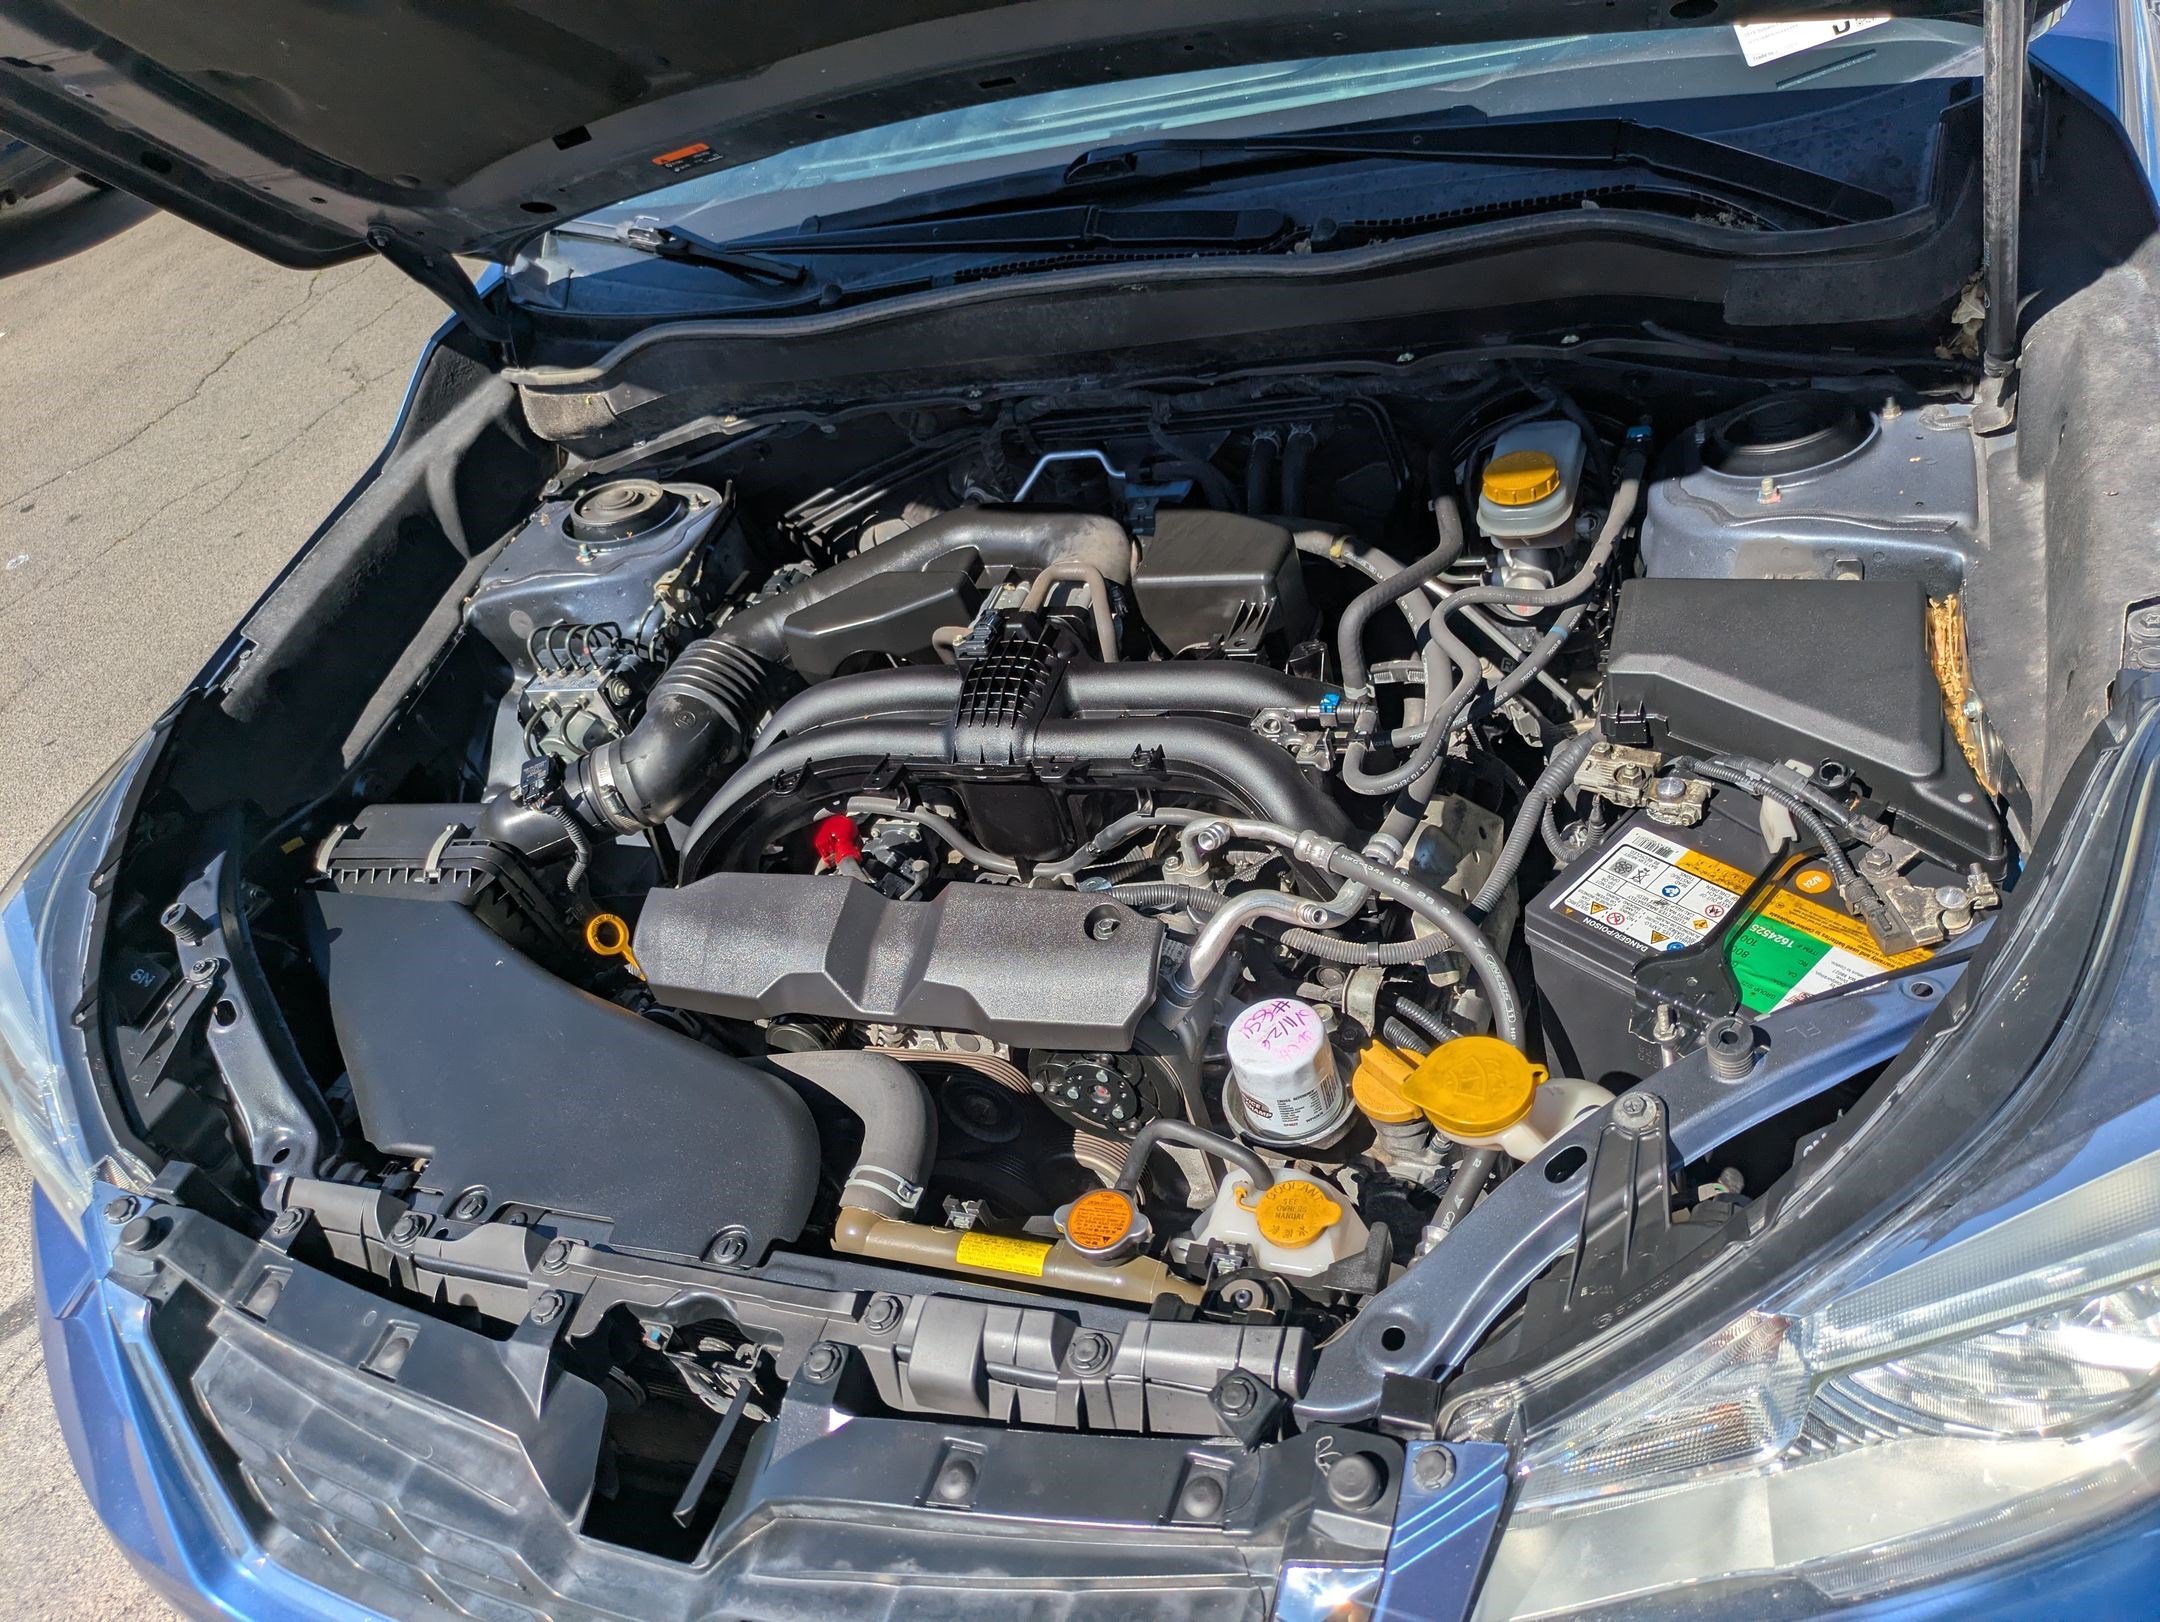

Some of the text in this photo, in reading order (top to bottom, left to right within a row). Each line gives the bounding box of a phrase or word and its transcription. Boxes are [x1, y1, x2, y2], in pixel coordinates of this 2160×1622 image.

[1705, 884, 1731, 897] CHILDREN
[1582, 916, 1648, 952] DANGER/POISON
[1740, 934, 1758, 948] 100
[1750, 923, 1795, 949] 1624525
[1819, 933, 1846, 947] batteries
[1844, 945, 1859, 953] used
[1869, 955, 1895, 969] warranty
[1752, 986, 1777, 999] GROUP
[1266, 1182, 1324, 1201] COOLANT
[1275, 1212, 1306, 1220] MANUAL
